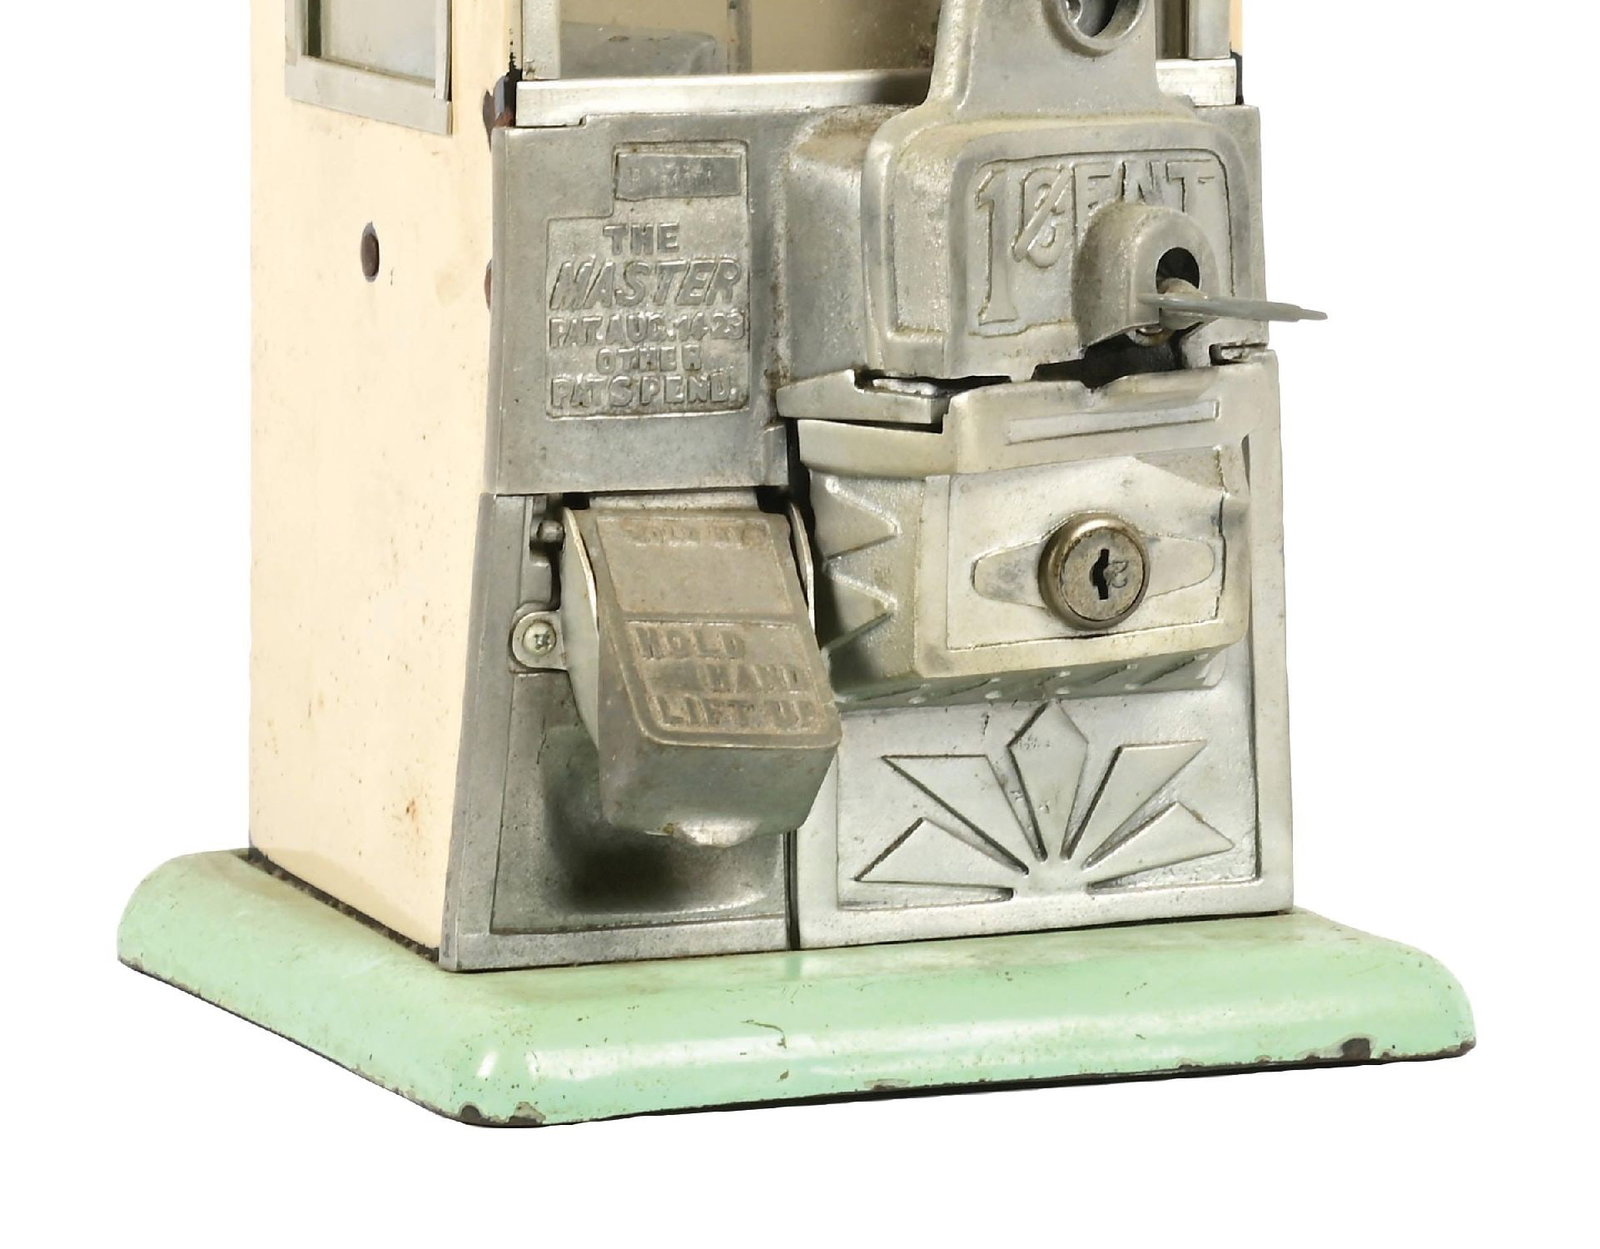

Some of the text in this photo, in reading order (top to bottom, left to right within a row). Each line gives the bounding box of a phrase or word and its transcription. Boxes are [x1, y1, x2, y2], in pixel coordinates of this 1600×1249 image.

[602, 222, 681, 256] THE
[548, 255, 744, 312] MASTER
[595, 344, 703, 374] OTHER
[634, 625, 745, 660] HOLD
